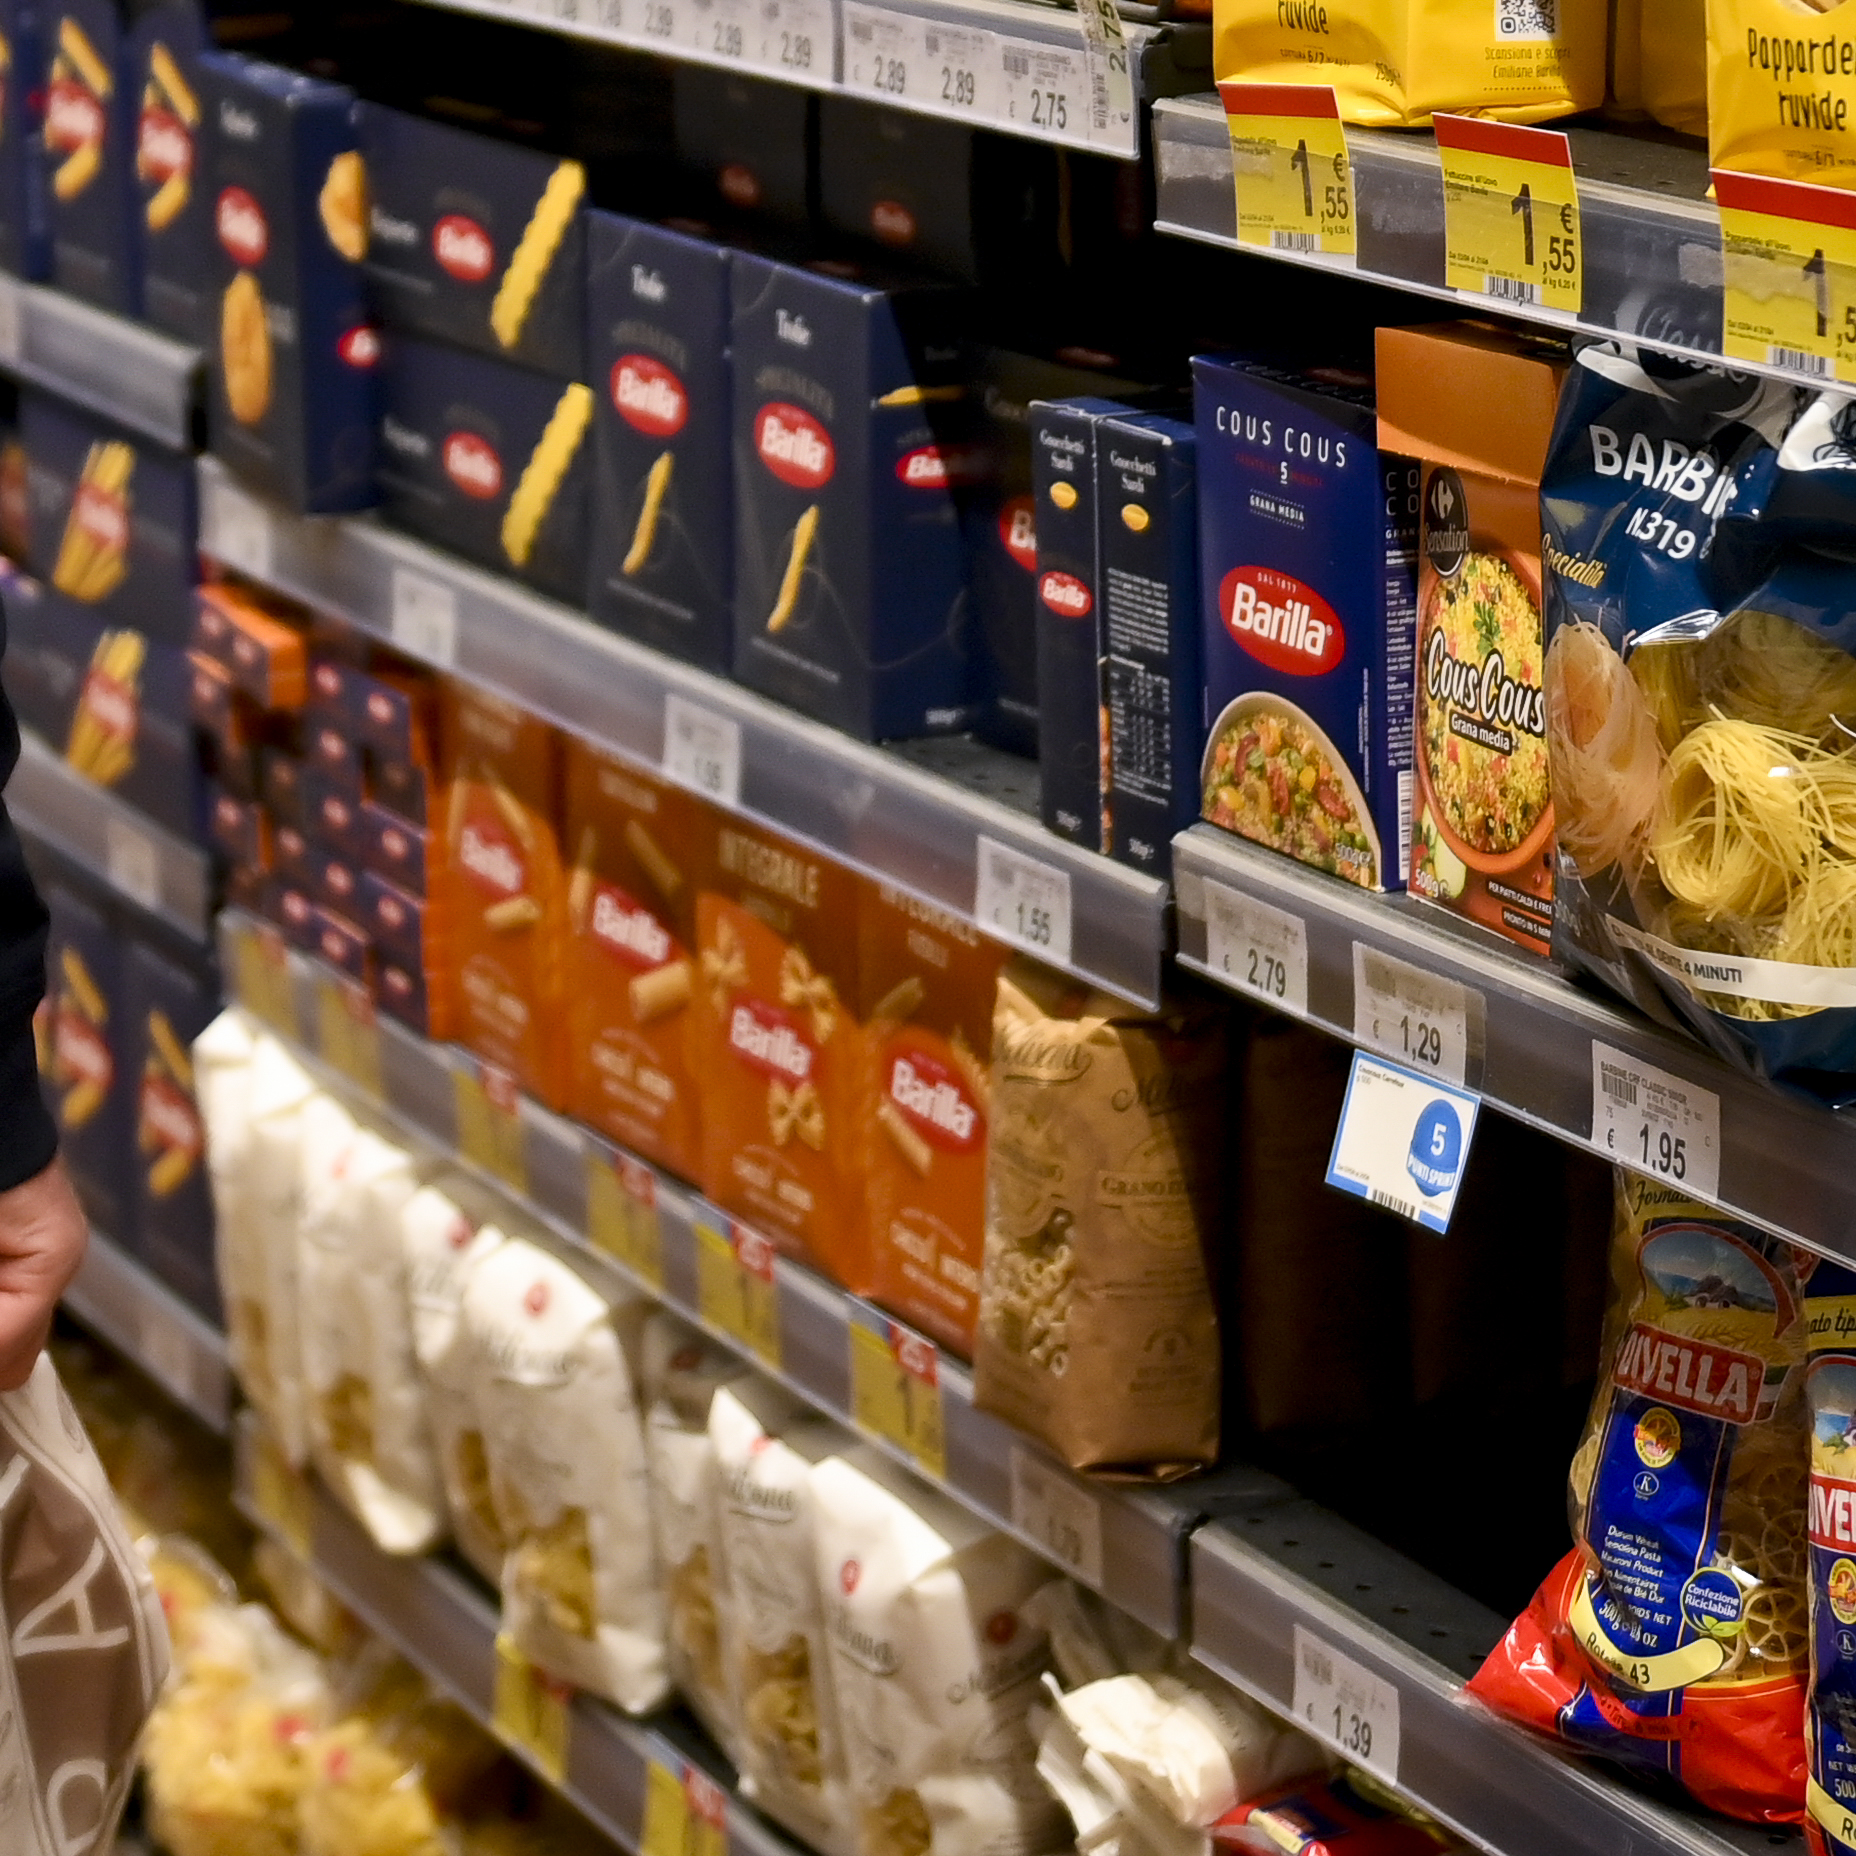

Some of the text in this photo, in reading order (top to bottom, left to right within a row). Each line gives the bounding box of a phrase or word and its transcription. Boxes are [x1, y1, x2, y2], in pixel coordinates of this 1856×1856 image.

[1485, 46, 1533, 61] Scansiona
[942, 66, 976, 107] 2,89
[1493, 65, 1534, 80] Emiliane
[1030, 88, 1068, 130] 2,75
[1778, 89, 1848, 132] ruvide
[1291, 139, 1314, 217] 1
[1512, 182, 1535, 266] 1
[1801, 248, 1828, 337] 1
[759, 415, 829, 475] Barilla
[1217, 406, 1346, 467] COUS COUS
[1110, 449, 1157, 477] Gnocchetti
[1280, 461, 1288, 480] 5
[1588, 423, 1740, 523] BARBI
[1121, 474, 1145, 495] Sardi
[1250, 494, 1305, 522] GRANA MEDIA
[1231, 582, 1328, 657] Barilla
[1428, 628, 1544, 735] Cous Cous
[1450, 714, 1511, 752] Grana media
[1413, 867, 1440, 899] 500g
[1247, 948, 1287, 998] 2,79
[1693, 962, 1743, 984] MINUTI
[1400, 1014, 1442, 1066] 1,29
[1600, 1059, 1629, 1084] BARBINE
[890, 1055, 976, 1141] Barilla
[1430, 1122, 1447, 1157] 5
[1406, 1152, 1456, 1190] PUNTI SPRINT
[1633, 1560, 1664, 1578] Product
[1639, 1547, 1663, 1564] Pasta
[1684, 1594, 1738, 1619] Riciclabile
[1687, 1584, 1740, 1606] Confezione
[1652, 1612, 1673, 1626] NET
[1629, 1662, 1651, 1685] 43
